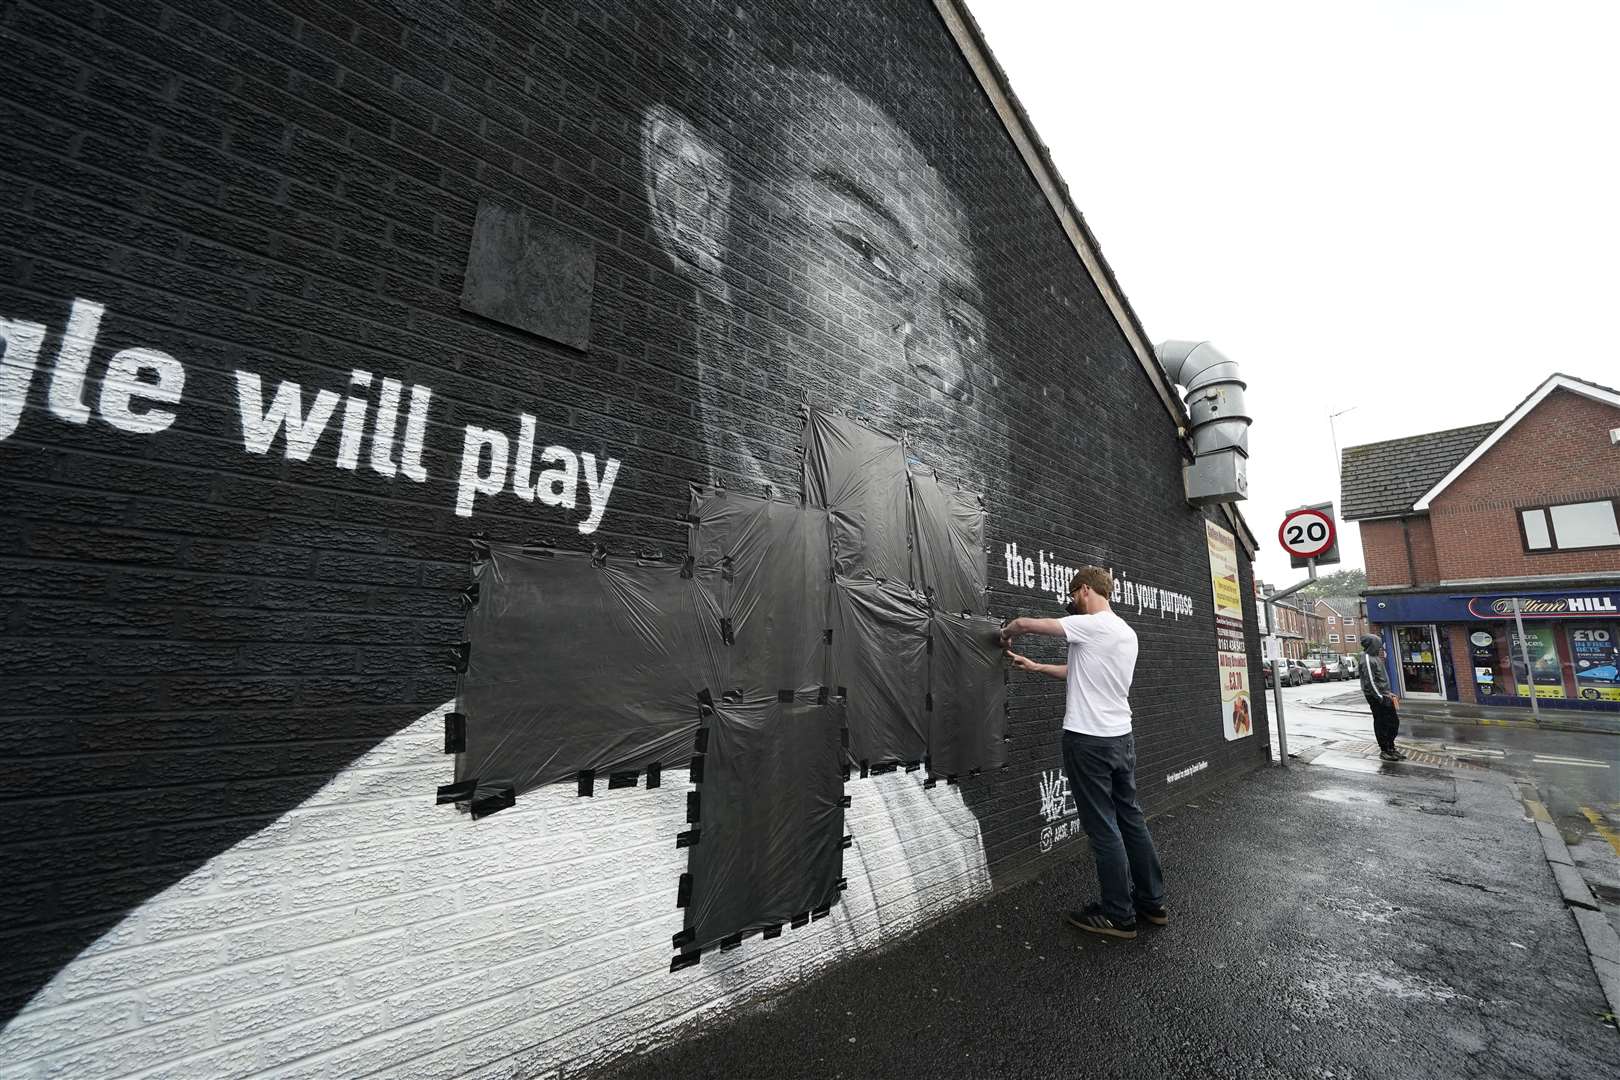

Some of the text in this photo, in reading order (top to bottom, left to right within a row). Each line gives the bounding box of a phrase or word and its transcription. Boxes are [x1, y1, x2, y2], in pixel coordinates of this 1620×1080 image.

[235, 369, 432, 483] will
[455, 412, 621, 534] play
[1287, 522, 1326, 544] 20
[1005, 542, 1035, 588] the
[1039, 549, 1080, 605] bigg
[1122, 571, 1135, 606] in
[1135, 583, 1158, 616] your
[1159, 588, 1194, 621] purpose
[1567, 597, 1616, 611] HILL
[1573, 630, 1610, 641] £10
